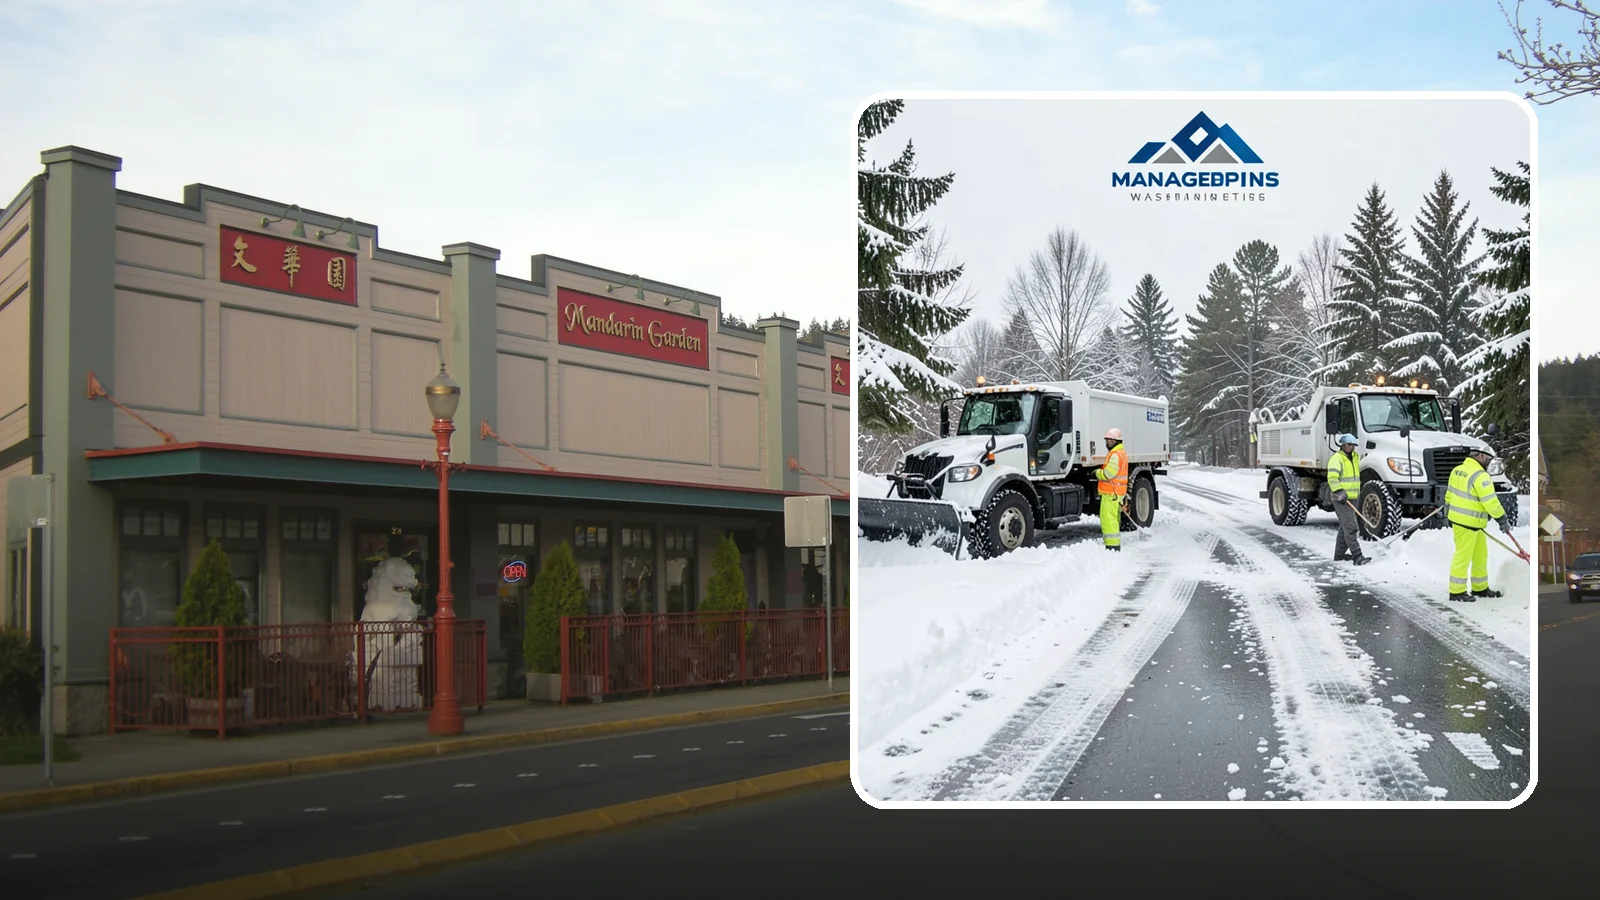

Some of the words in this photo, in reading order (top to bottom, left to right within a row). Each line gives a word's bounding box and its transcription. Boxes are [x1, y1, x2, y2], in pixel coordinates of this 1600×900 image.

[231, 235, 346, 291] 文華園
[564, 302, 644, 341] Mandarin
[647, 320, 702, 352] Garden
[503, 565, 527, 578] OPEN
